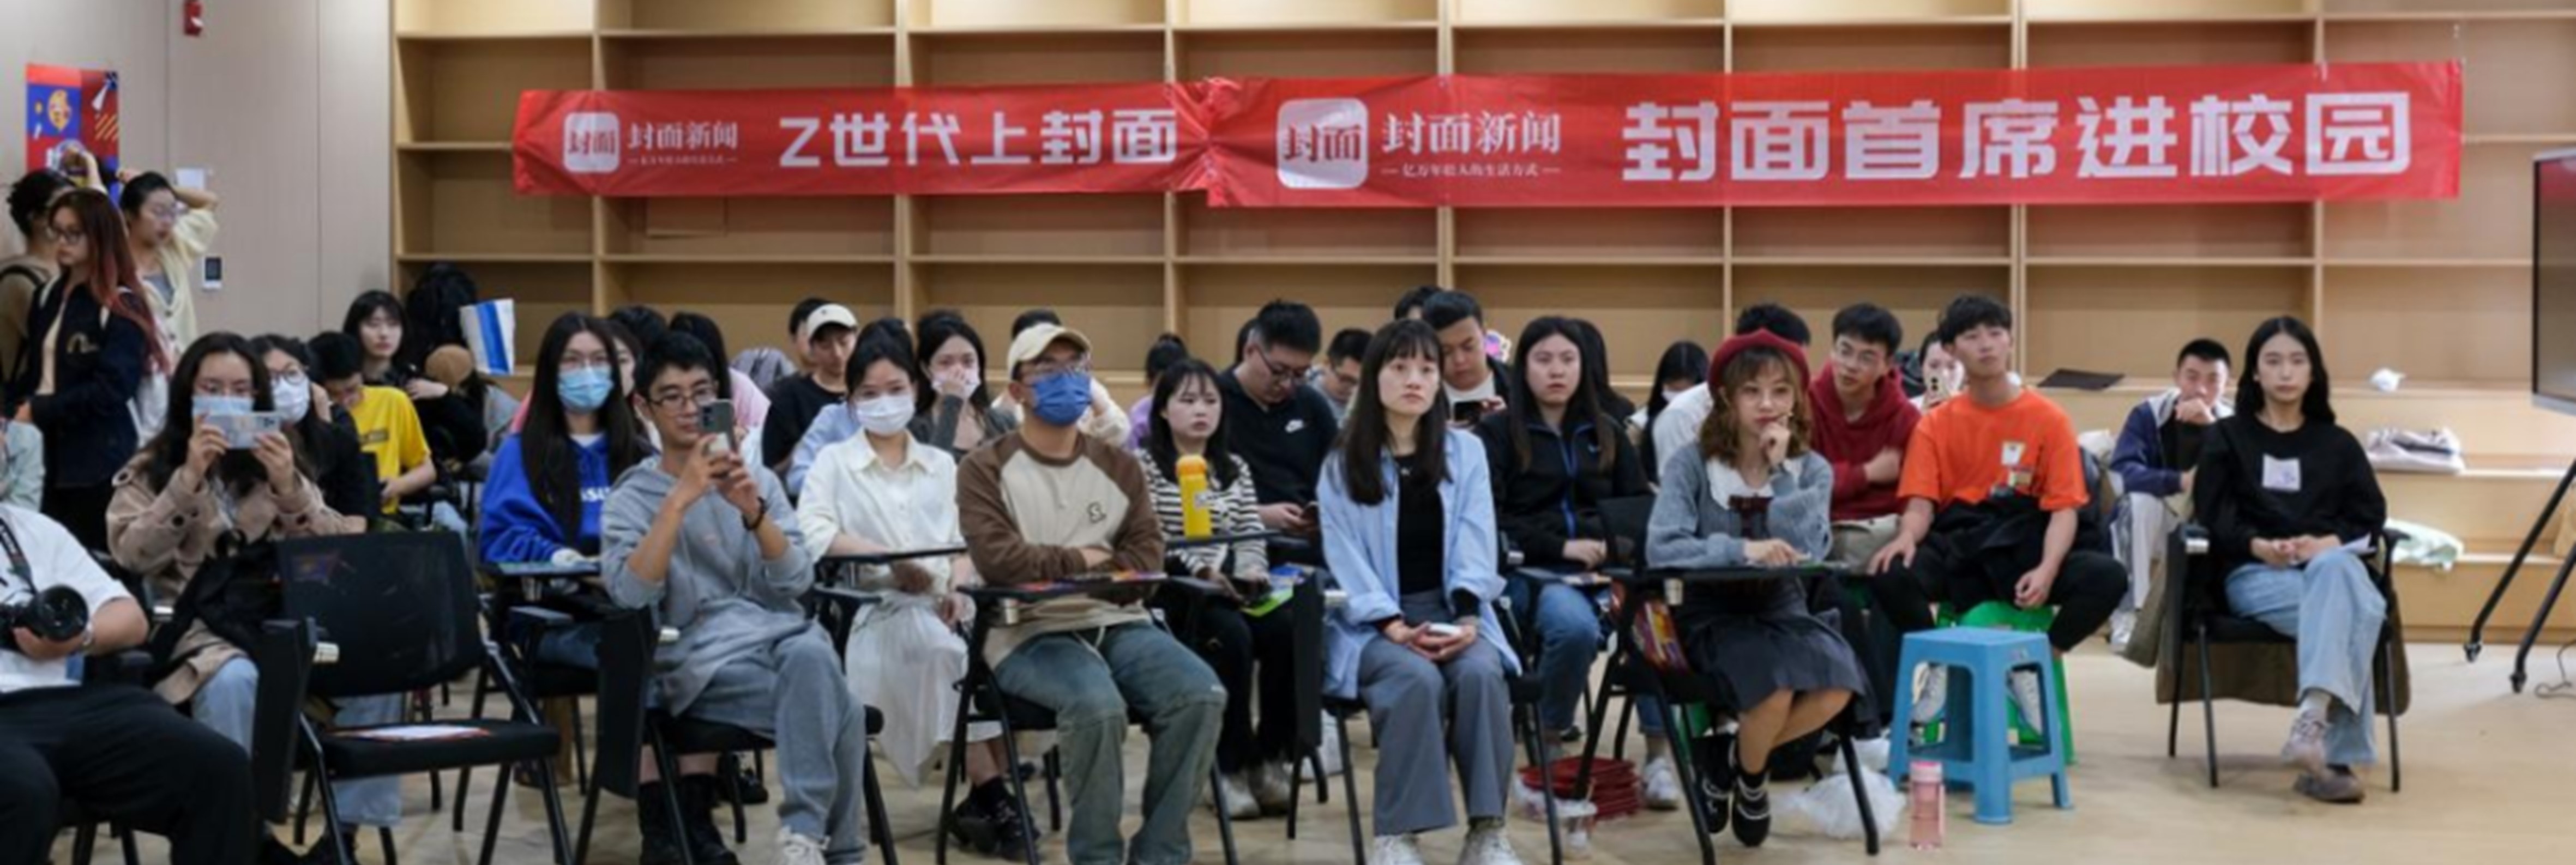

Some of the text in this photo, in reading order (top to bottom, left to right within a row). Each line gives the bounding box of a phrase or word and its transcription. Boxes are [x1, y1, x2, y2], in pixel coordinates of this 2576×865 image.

[627, 121, 737, 149] 封面新闻
[779, 109, 1177, 167] Z世代上封面
[1284, 124, 1362, 162] 封面
[1382, 111, 1561, 154] 封面新闻
[1622, 94, 2410, 181] 封面首席进校园
